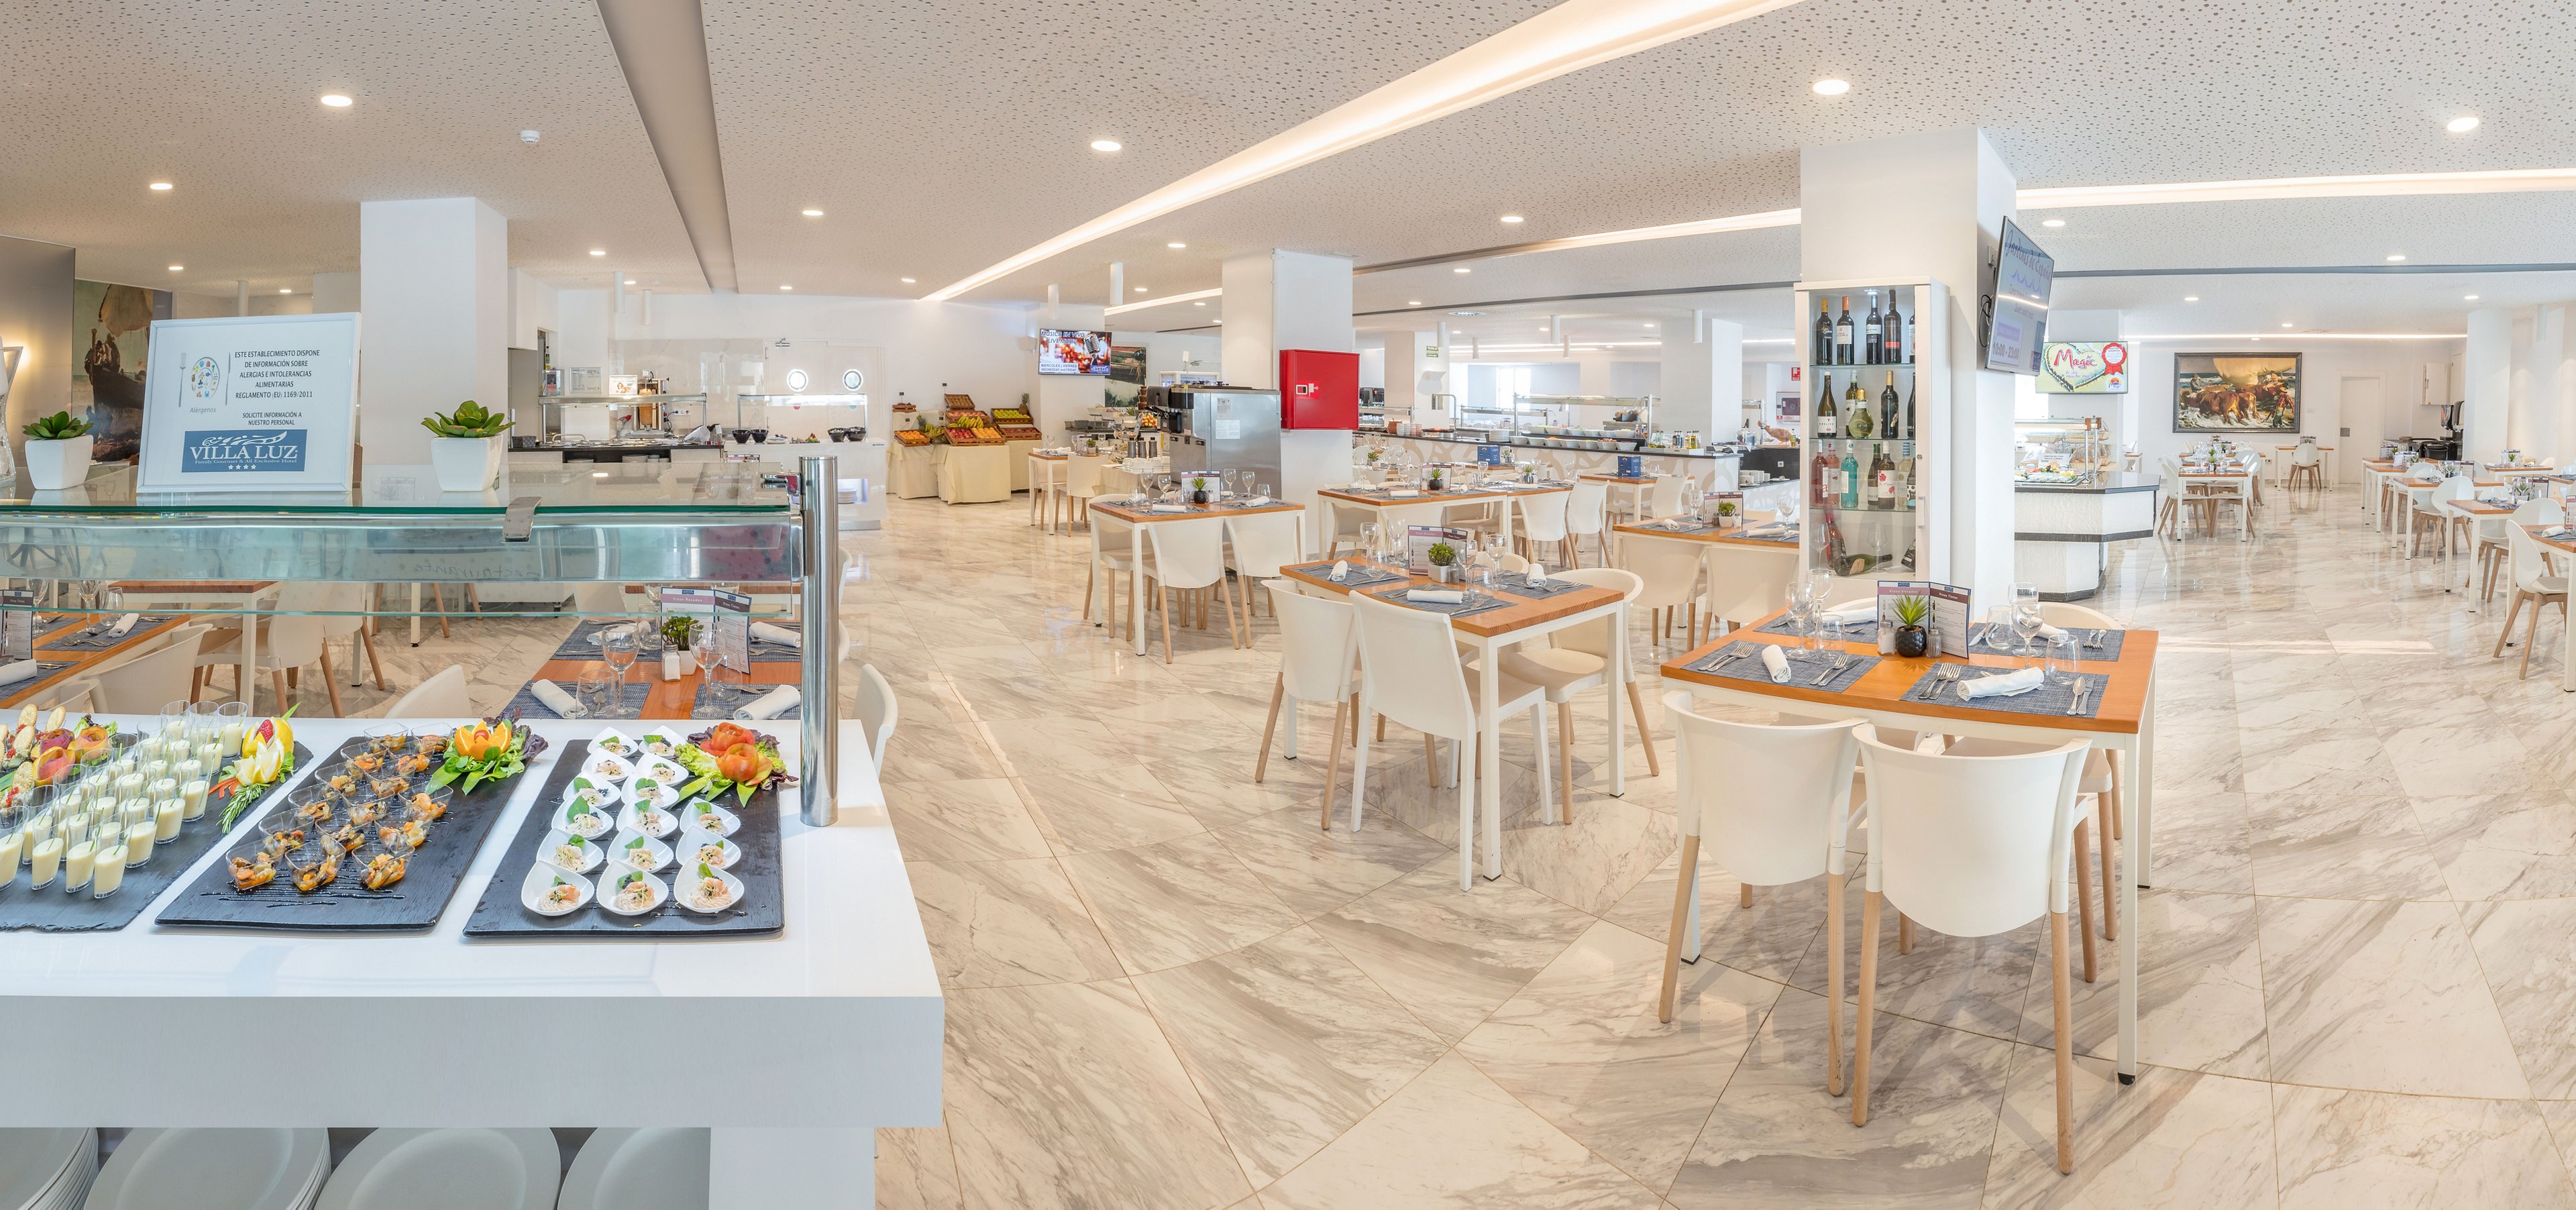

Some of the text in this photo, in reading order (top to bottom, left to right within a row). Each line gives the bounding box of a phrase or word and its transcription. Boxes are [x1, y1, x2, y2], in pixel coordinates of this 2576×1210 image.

[2029, 249, 2035, 270] de
[252, 360, 290, 368] INFORMACIÓN
[2053, 349, 2098, 369] Magic
[190, 445, 299, 459] VILLA LUZ
